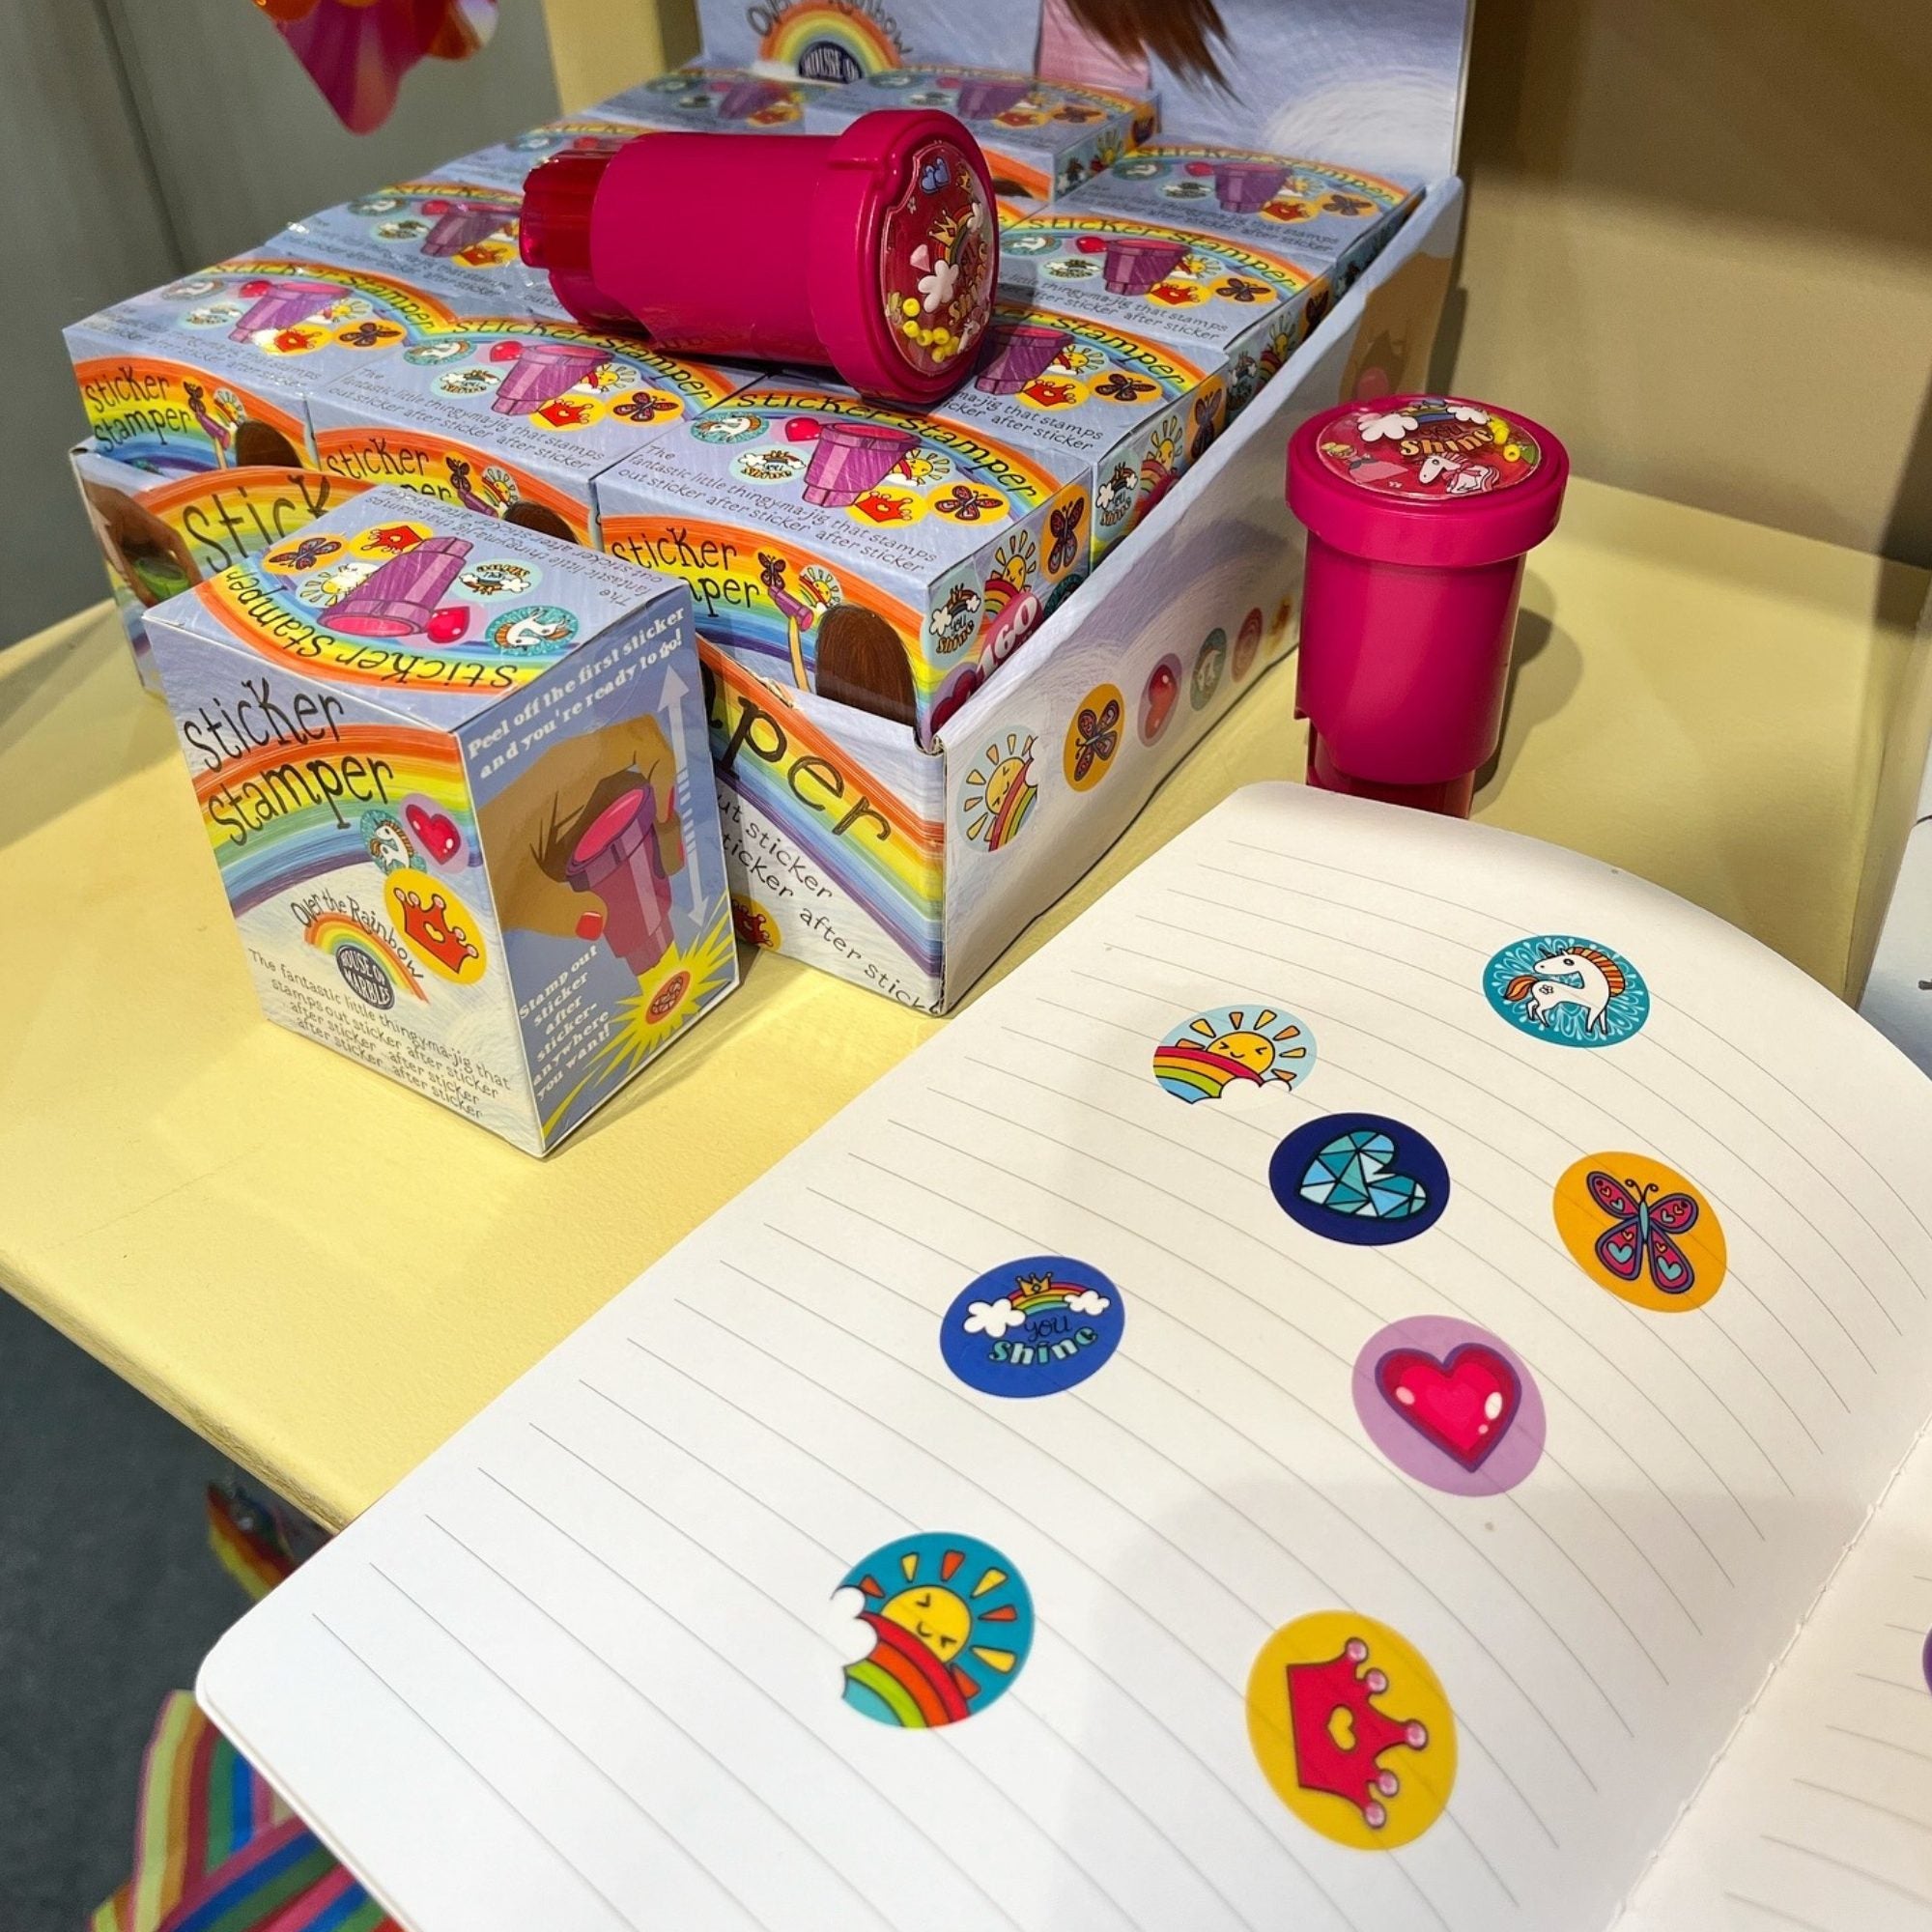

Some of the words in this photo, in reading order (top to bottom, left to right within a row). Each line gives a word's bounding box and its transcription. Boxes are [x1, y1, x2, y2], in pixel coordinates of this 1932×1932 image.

[1123, 307, 1164, 326] after
[403, 404, 441, 425] after
[440, 417, 495, 440] sticker
[497, 433, 534, 453] after
[533, 446, 593, 471] sticker
[512, 425, 545, 444] that
[548, 436, 607, 462] stamps
[648, 445, 676, 462] The
[943, 401, 986, 419] icker
[991, 412, 1035, 433] after
[1033, 425, 1094, 451] sticker
[1004, 403, 1039, 423] that
[1041, 413, 1104, 440] stamps
[617, 469, 647, 484] out
[647, 476, 707, 499] sticker
[705, 496, 751, 514] after
[750, 508, 811, 532] sticker
[815, 528, 861, 549] after
[860, 545, 925, 573] sticker
[630, 454, 692, 480] fantastic
[691, 472, 727, 491] little
[831, 519, 869, 539] that
[868, 532, 938, 563] stamps
[467, 719, 511, 760] Peel
[514, 696, 542, 727] off
[542, 678, 577, 708] the
[578, 648, 621, 685] first
[622, 607, 686, 657] sticker
[479, 741, 520, 780] and
[585, 664, 638, 708] ready
[639, 650, 658, 671] to
[659, 628, 684, 660] go!
[717, 793, 744, 823] ut
[745, 822, 834, 899] sticker
[291, 893, 324, 927] Over
[322, 888, 347, 914] the
[346, 895, 424, 980] Rainbow
[723, 833, 794, 897] ticker
[799, 905, 863, 961] after
[340, 949, 373, 978] HOUSE
[343, 968, 390, 1005] MARBLES
[518, 970, 570, 1020] Stamp
[570, 945, 599, 974] out
[533, 971, 589, 1028] sticker
[248, 948, 276, 972] The
[280, 963, 342, 1003] fantastic
[344, 993, 376, 1020] little
[474, 1061, 511, 1091] that
[270, 977, 325, 1015] stamps
[325, 1007, 351, 1026] out
[353, 1015, 404, 1050] sticker
[406, 1043, 442, 1070] after
[446, 1064, 498, 1099] sticker
[289, 1000, 325, 1025] after
[326, 1018, 377, 1051] sticker
[387, 1049, 424, 1076] after
[428, 1068, 480, 1104] sticker
[532, 1010, 611, 1087] anywhere
[536, 1002, 598, 1064] sticker-
[544, 995, 582, 1037] after
[297, 1016, 331, 1041] after
[333, 1035, 384, 1068] sticker
[390, 1065, 429, 1092] after
[431, 1085, 484, 1119] sticker
[536, 1069, 564, 1102] you
[565, 1022, 611, 1070] want!
[1023, 1315, 1073, 1344] you
